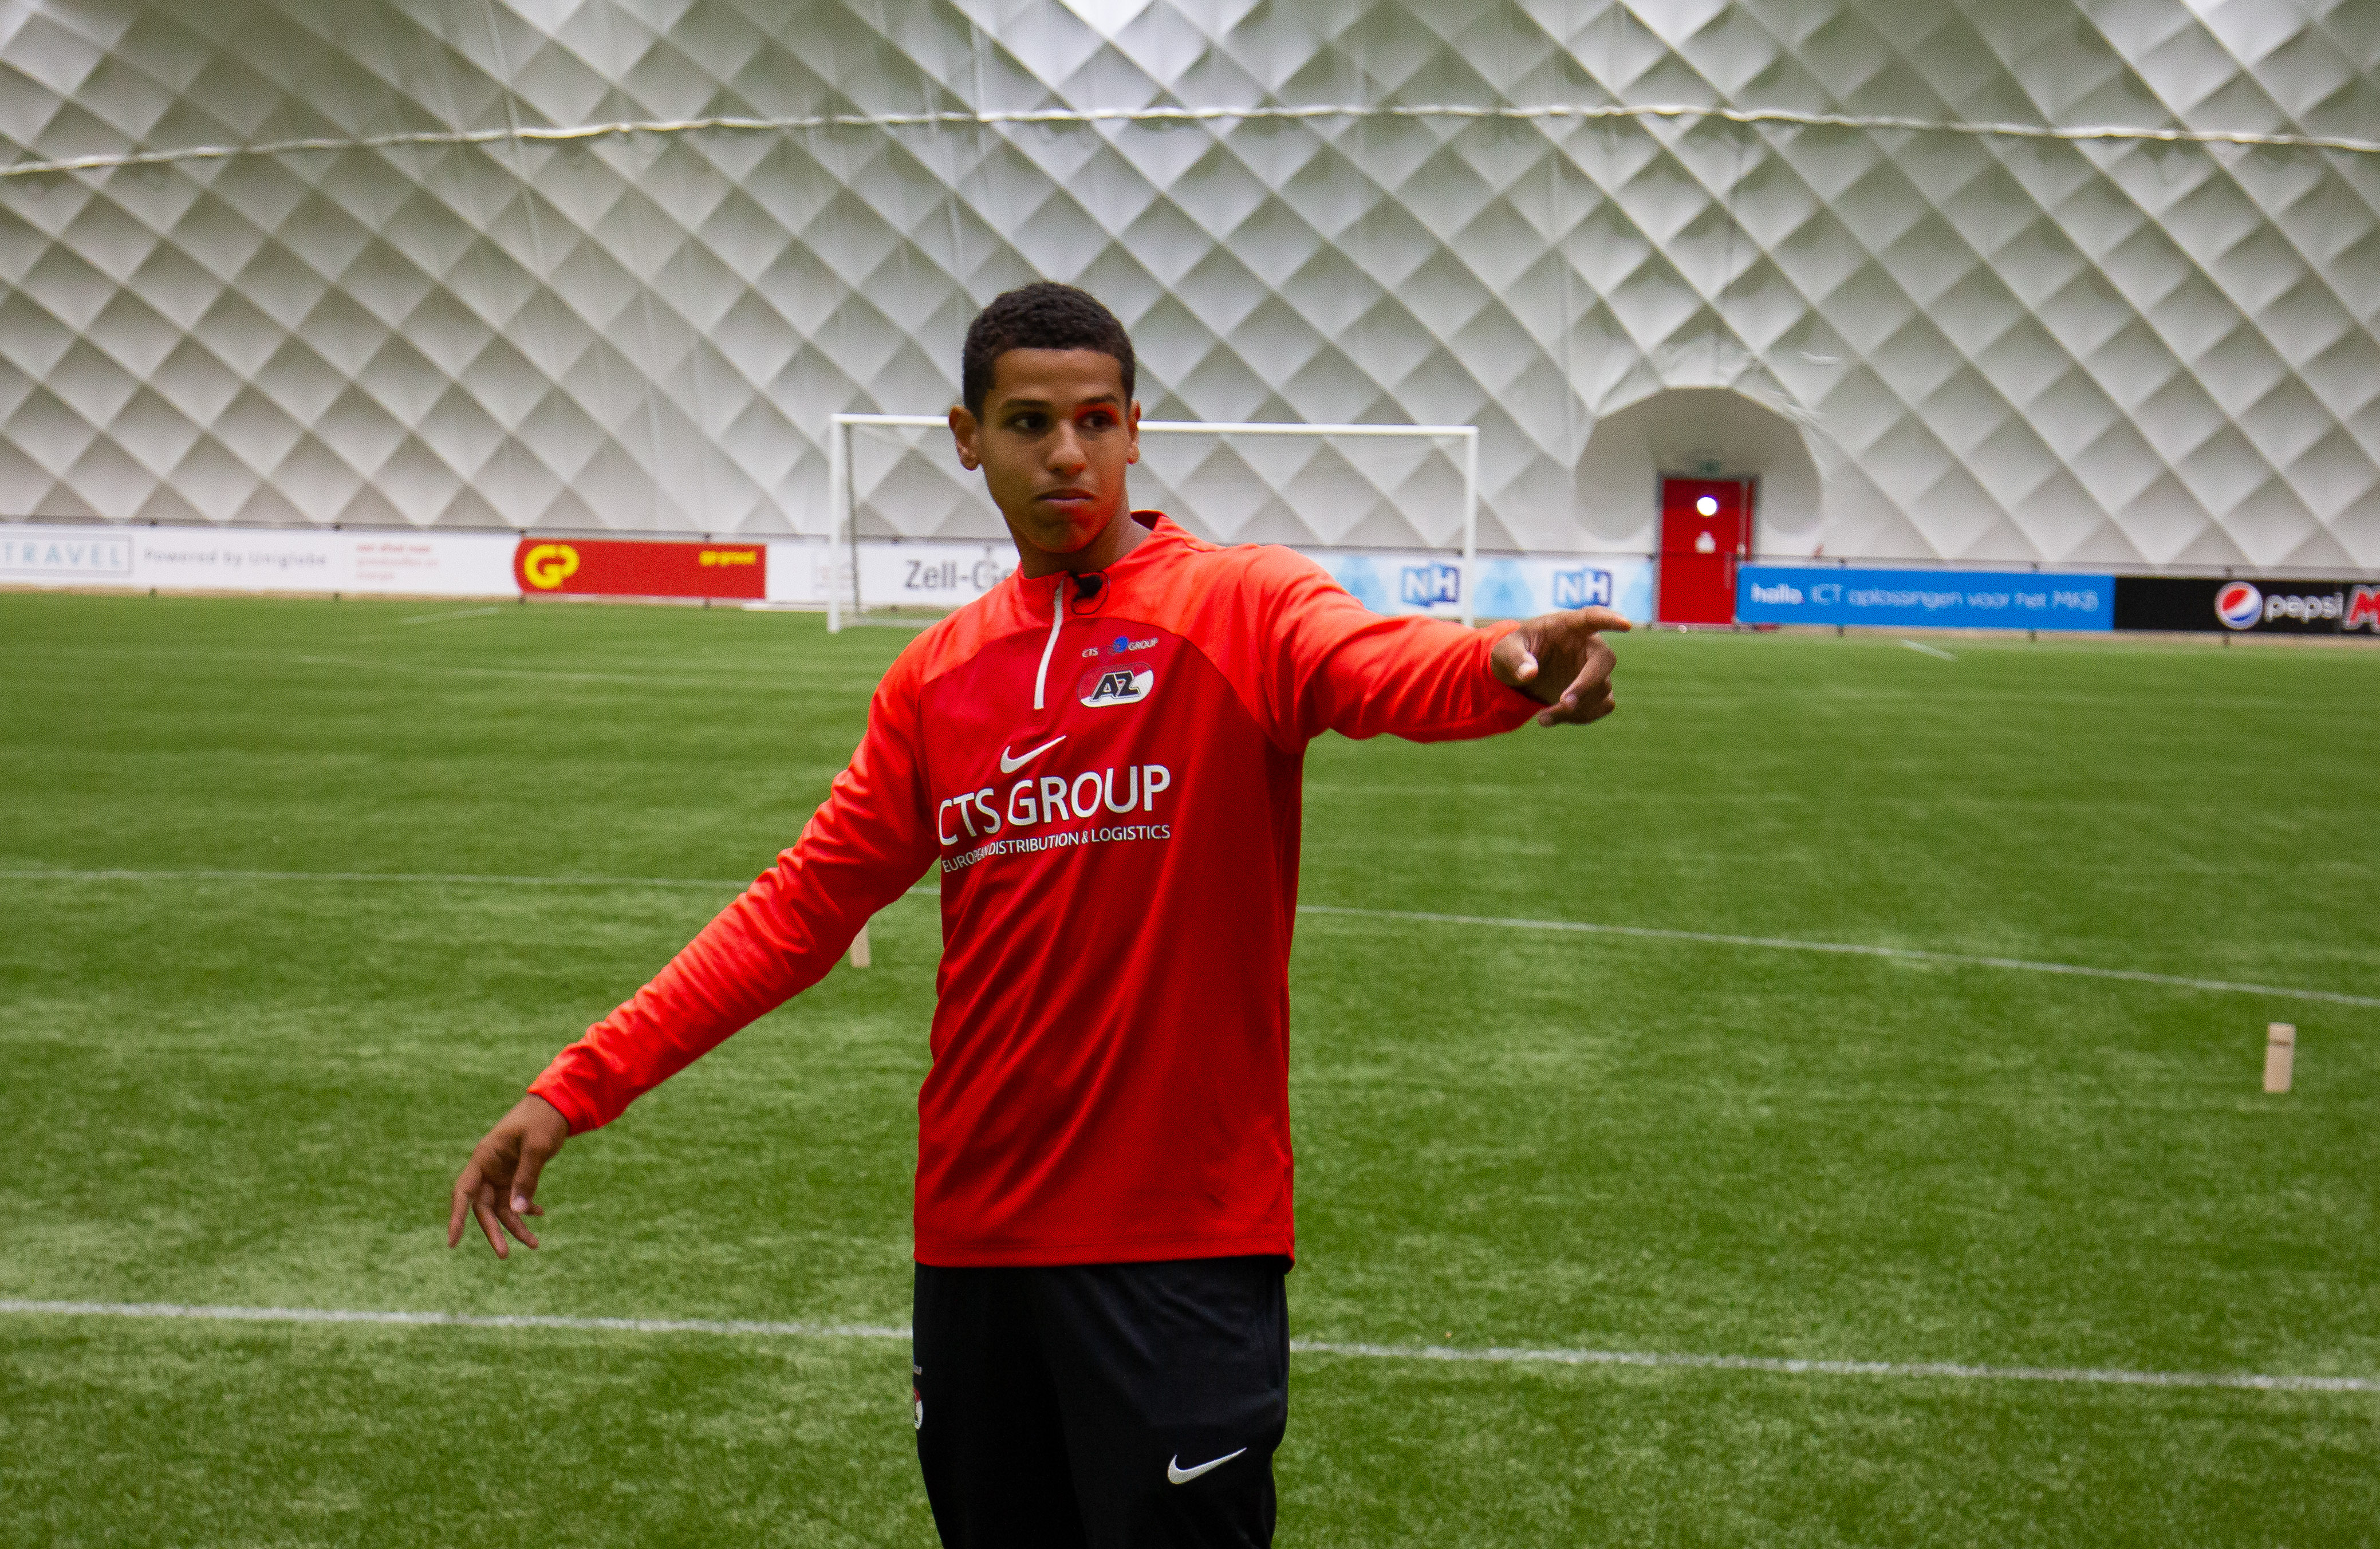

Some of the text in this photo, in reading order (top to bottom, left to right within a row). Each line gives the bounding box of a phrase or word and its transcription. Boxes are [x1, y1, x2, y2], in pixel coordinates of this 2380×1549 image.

[4, 541, 121, 566] TRAVEL
[1405, 565, 1457, 602] NH
[1557, 567, 1611, 604] NH
[2264, 592, 2344, 623] pepsi
[1128, 637, 1159, 651] GROUP
[1090, 669, 1141, 702] AZ
[938, 764, 1171, 846] CTS GROUP
[988, 831, 1079, 856] DISTRIBUTION
[1081, 830, 1089, 844] &
[1090, 824, 1171, 843] LOGISTICS
